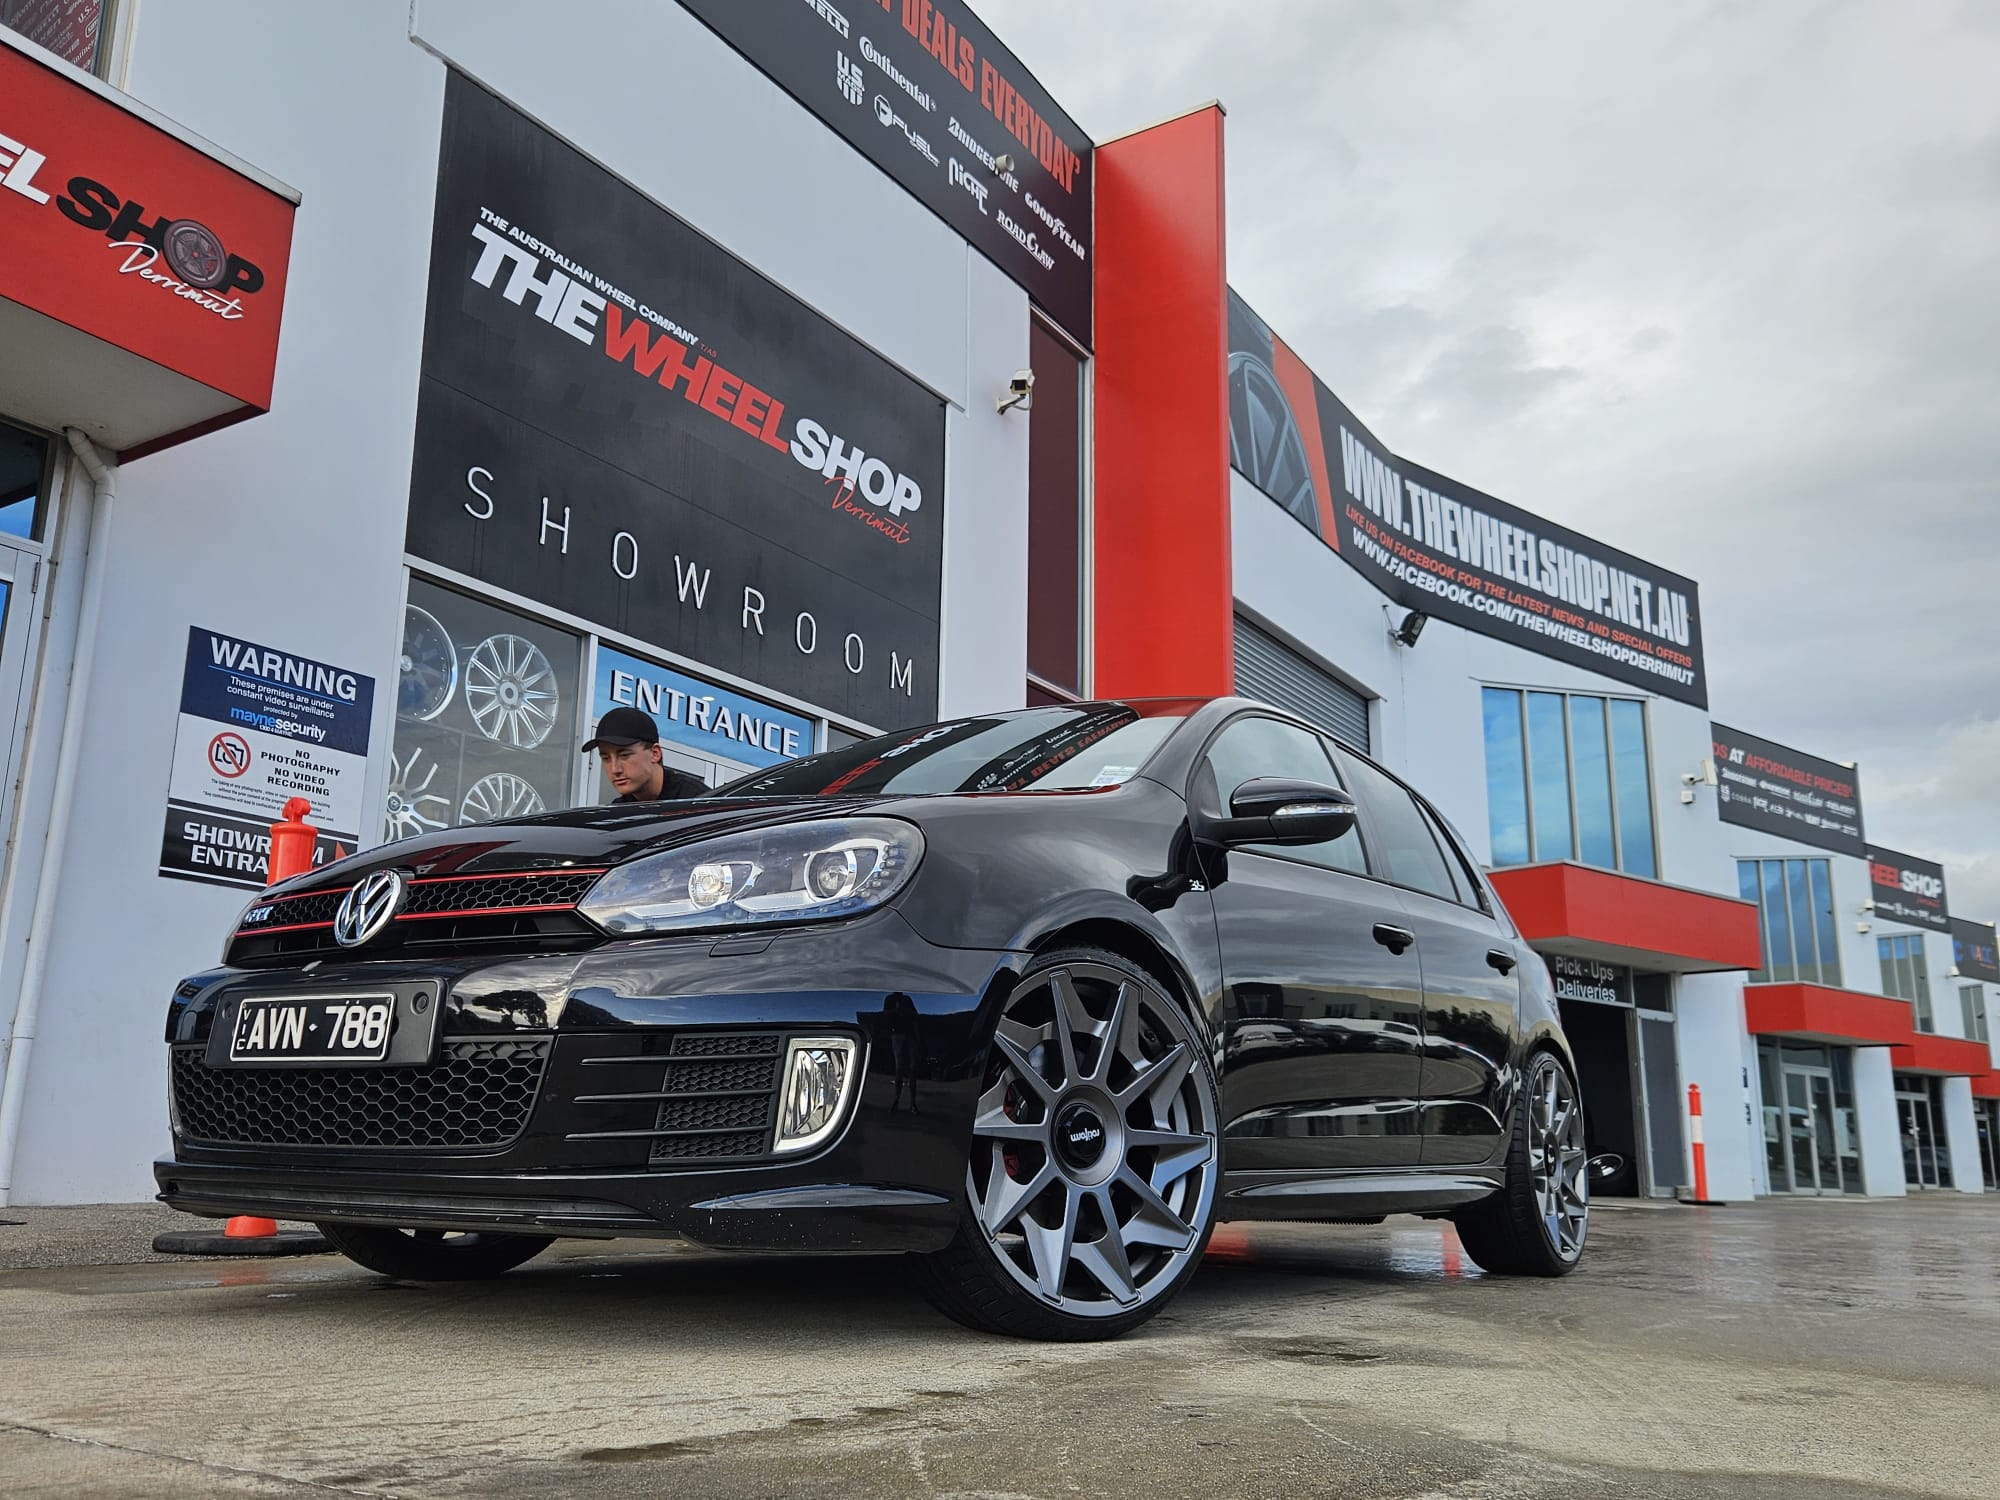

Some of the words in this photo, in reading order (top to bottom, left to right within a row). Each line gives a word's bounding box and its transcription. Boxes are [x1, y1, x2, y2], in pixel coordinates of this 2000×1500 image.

[860, 36, 930, 112] Continental
[902, 0, 975, 93] DEALS
[948, 116, 1019, 192] BRIDGESONE
[1025, 192, 1085, 260] GOODYEAR
[107, 241, 244, 320] Derrimut
[481, 207, 508, 232] THE
[508, 226, 594, 284] AUSTRALIAN
[594, 276, 637, 312] WHEEL
[638, 304, 699, 346] COMPANY
[790, 417, 922, 517] SHOP
[824, 476, 911, 545] Derrimut
[1339, 425, 1690, 647] WWW.THEWHEELSHOP.NET.AU
[1346, 503, 1364, 528] LIKE
[1365, 520, 1378, 539] US
[1379, 530, 1394, 550] ON
[1394, 541, 1456, 580] FACEBOOK
[1457, 571, 1482, 590] FOR
[1483, 581, 1506, 600] THE
[1508, 590, 1551, 616] LATEST
[1552, 608, 1585, 630] NEWS
[1586, 619, 1611, 638] AND
[1611, 628, 1654, 655] SPECIAL
[1655, 646, 1693, 668] OFFERS
[210, 636, 357, 701] WARNING
[231, 676, 256, 690] These
[257, 683, 295, 701] premises
[296, 694, 309, 704] are
[310, 697, 334, 711] under
[226, 685, 263, 702] constant
[264, 693, 287, 707] video
[288, 701, 335, 719] surveillance
[263, 705, 290, 718] protected
[290, 711, 299, 720] by
[610, 668, 800, 760] ENTRANCE
[260, 751, 341, 776] PHOTOGRAPHY
[274, 767, 290, 778] NO
[293, 771, 325, 786] VIDEO
[295, 749, 310, 760] NO
[1729, 747, 1745, 765] AT
[1745, 752, 1813, 787] AFFORDABLE
[267, 775, 330, 796] RECORDING
[1900, 869, 1943, 898] SHOP
[1555, 956, 1582, 977] Pick
[1590, 960, 1615, 984] Ups
[1556, 978, 1616, 1002] Deliveries
[246, 1006, 307, 1050] AVN
[325, 1005, 389, 1049] 788
